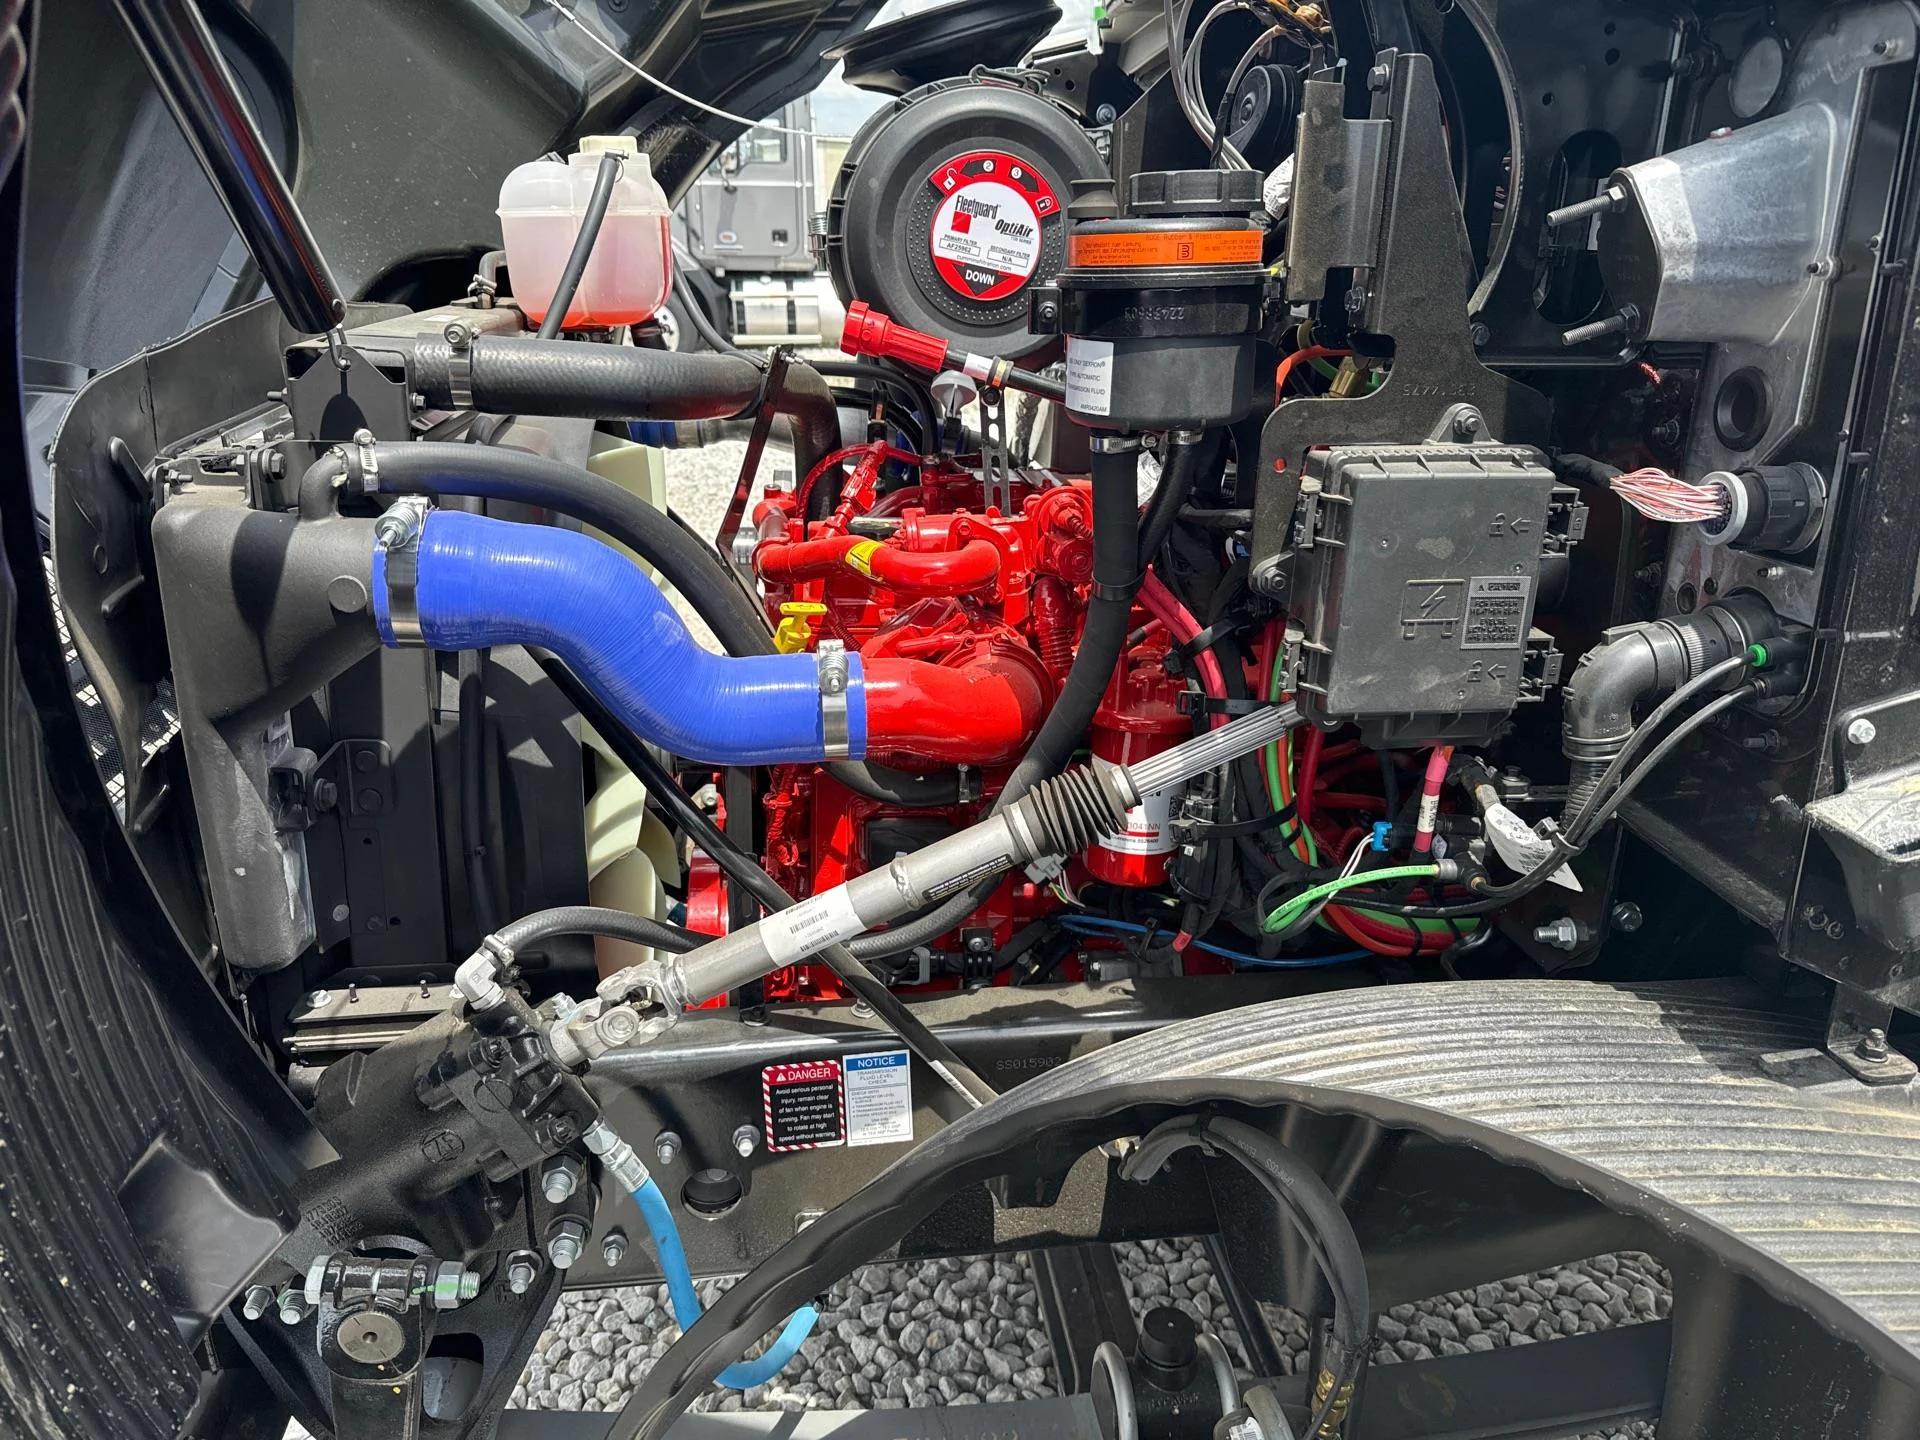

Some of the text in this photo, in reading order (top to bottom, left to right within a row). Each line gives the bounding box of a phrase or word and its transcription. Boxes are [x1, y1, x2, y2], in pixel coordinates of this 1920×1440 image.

[955, 195, 998, 220] Fleetguard
[995, 219, 1033, 238] OptiAir
[966, 270, 995, 286] DOWN
[858, 1056, 895, 1068] NOTICE
[788, 1068, 831, 1080] DANGER
[857, 1068, 898, 1076] TRANSMISSION
